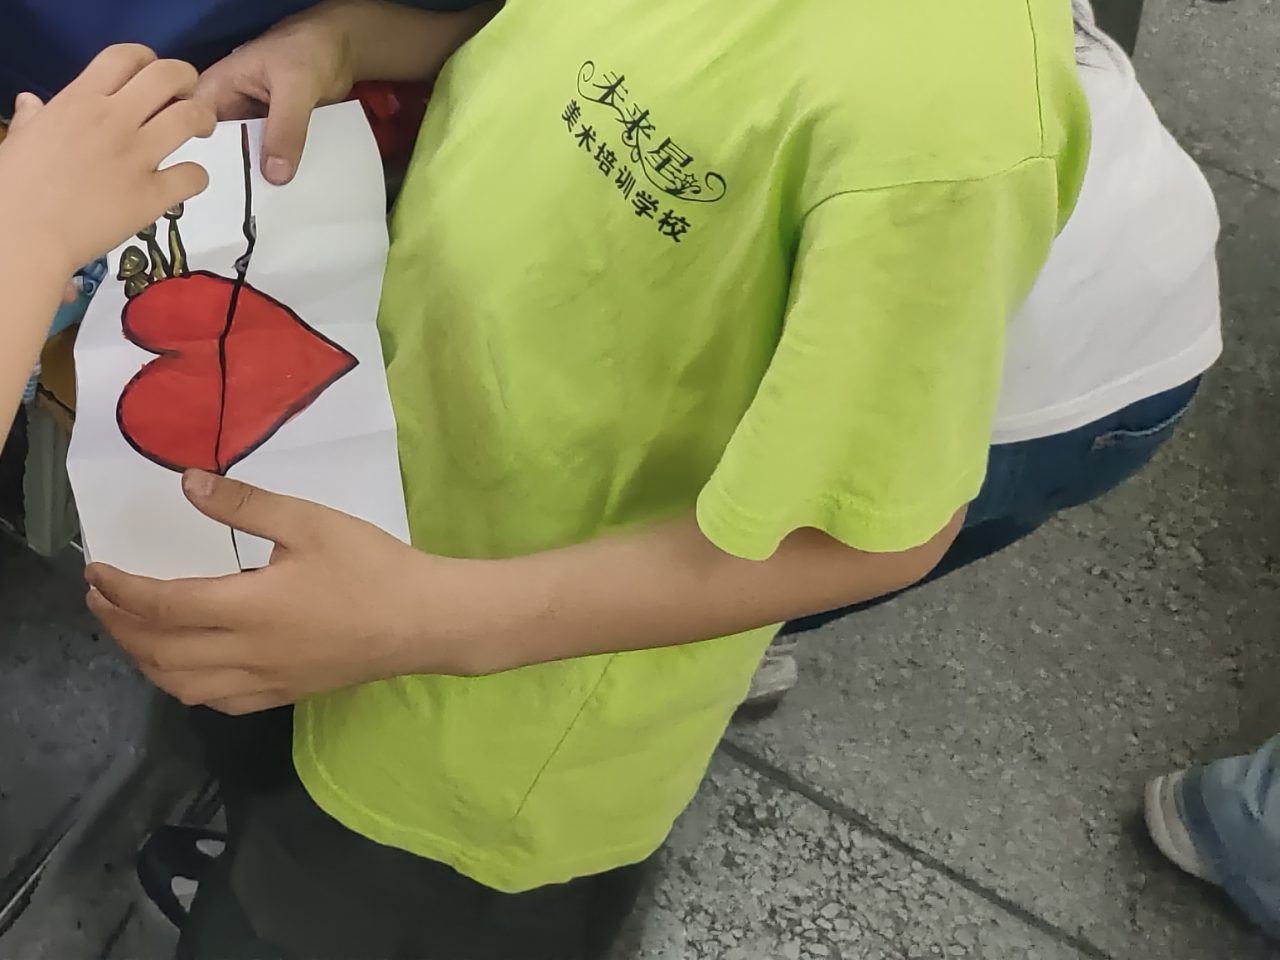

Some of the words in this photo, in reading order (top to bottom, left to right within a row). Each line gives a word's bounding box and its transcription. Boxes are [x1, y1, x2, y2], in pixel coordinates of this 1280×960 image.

[561, 98, 692, 243] 美术培训学校
[584, 66, 709, 194] 未来星
